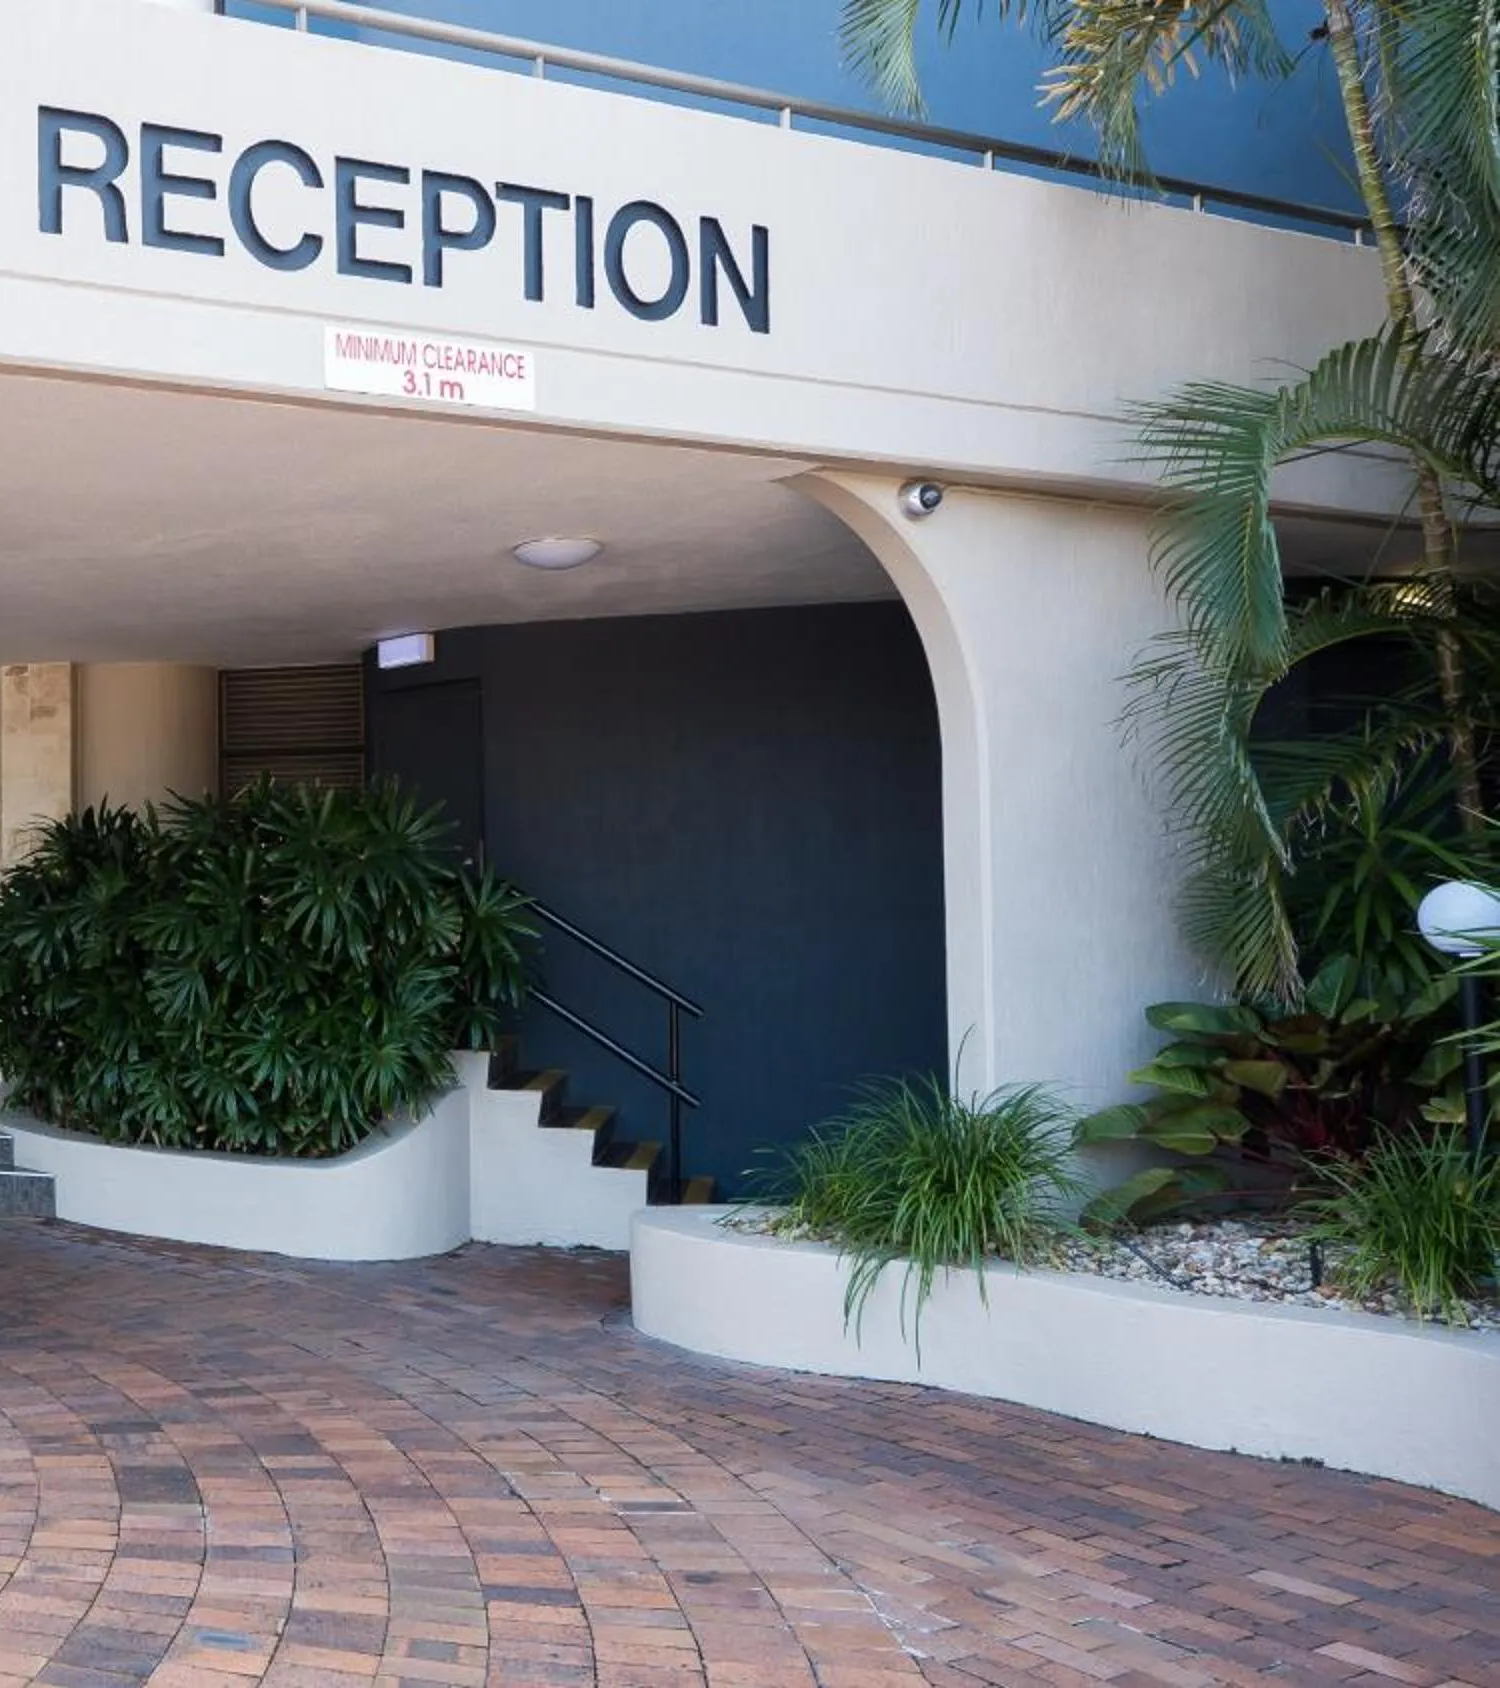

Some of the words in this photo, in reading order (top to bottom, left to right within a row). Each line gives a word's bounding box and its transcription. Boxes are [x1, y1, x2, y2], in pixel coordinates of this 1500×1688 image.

[38, 105, 770, 334] RECEPTION
[335, 333, 417, 367] MINIMUM
[423, 344, 525, 379] CLEARANCE
[403, 370, 431, 396] 3.1
[440, 379, 464, 400] m
